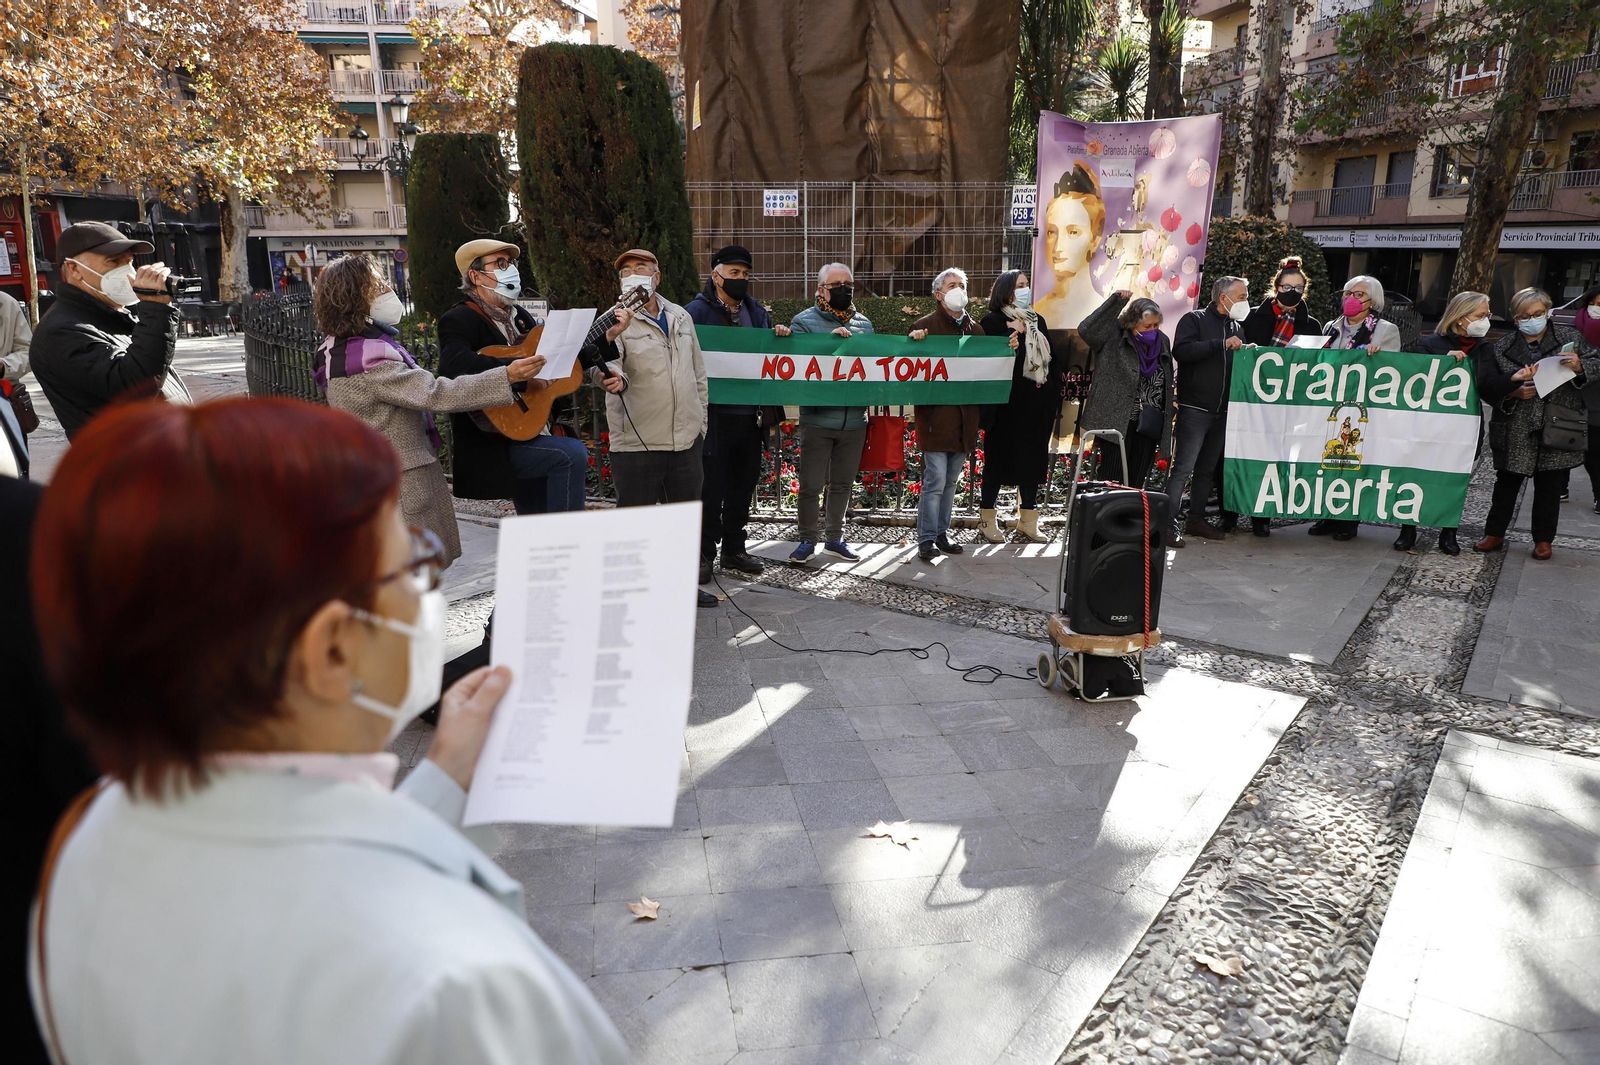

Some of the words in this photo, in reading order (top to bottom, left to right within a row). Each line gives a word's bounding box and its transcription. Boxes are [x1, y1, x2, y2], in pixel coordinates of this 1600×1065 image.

[1103, 145, 1127, 155] Granada
[1128, 144, 1149, 156] Abierta
[1013, 208, 1028, 219] 958
[1375, 233, 1397, 242] Servicio
[1398, 233, 1428, 242] Provincial
[1429, 233, 1461, 242] Tributario
[1503, 232, 1533, 241] Servicio
[1535, 232, 1576, 242] Provincial
[761, 355, 795, 380] NO
[805, 355, 822, 381] A
[832, 356, 866, 381] LA
[876, 356, 949, 381] TOMA
[1252, 352, 1471, 410] Granada
[1254, 463, 1424, 523] Abierta
